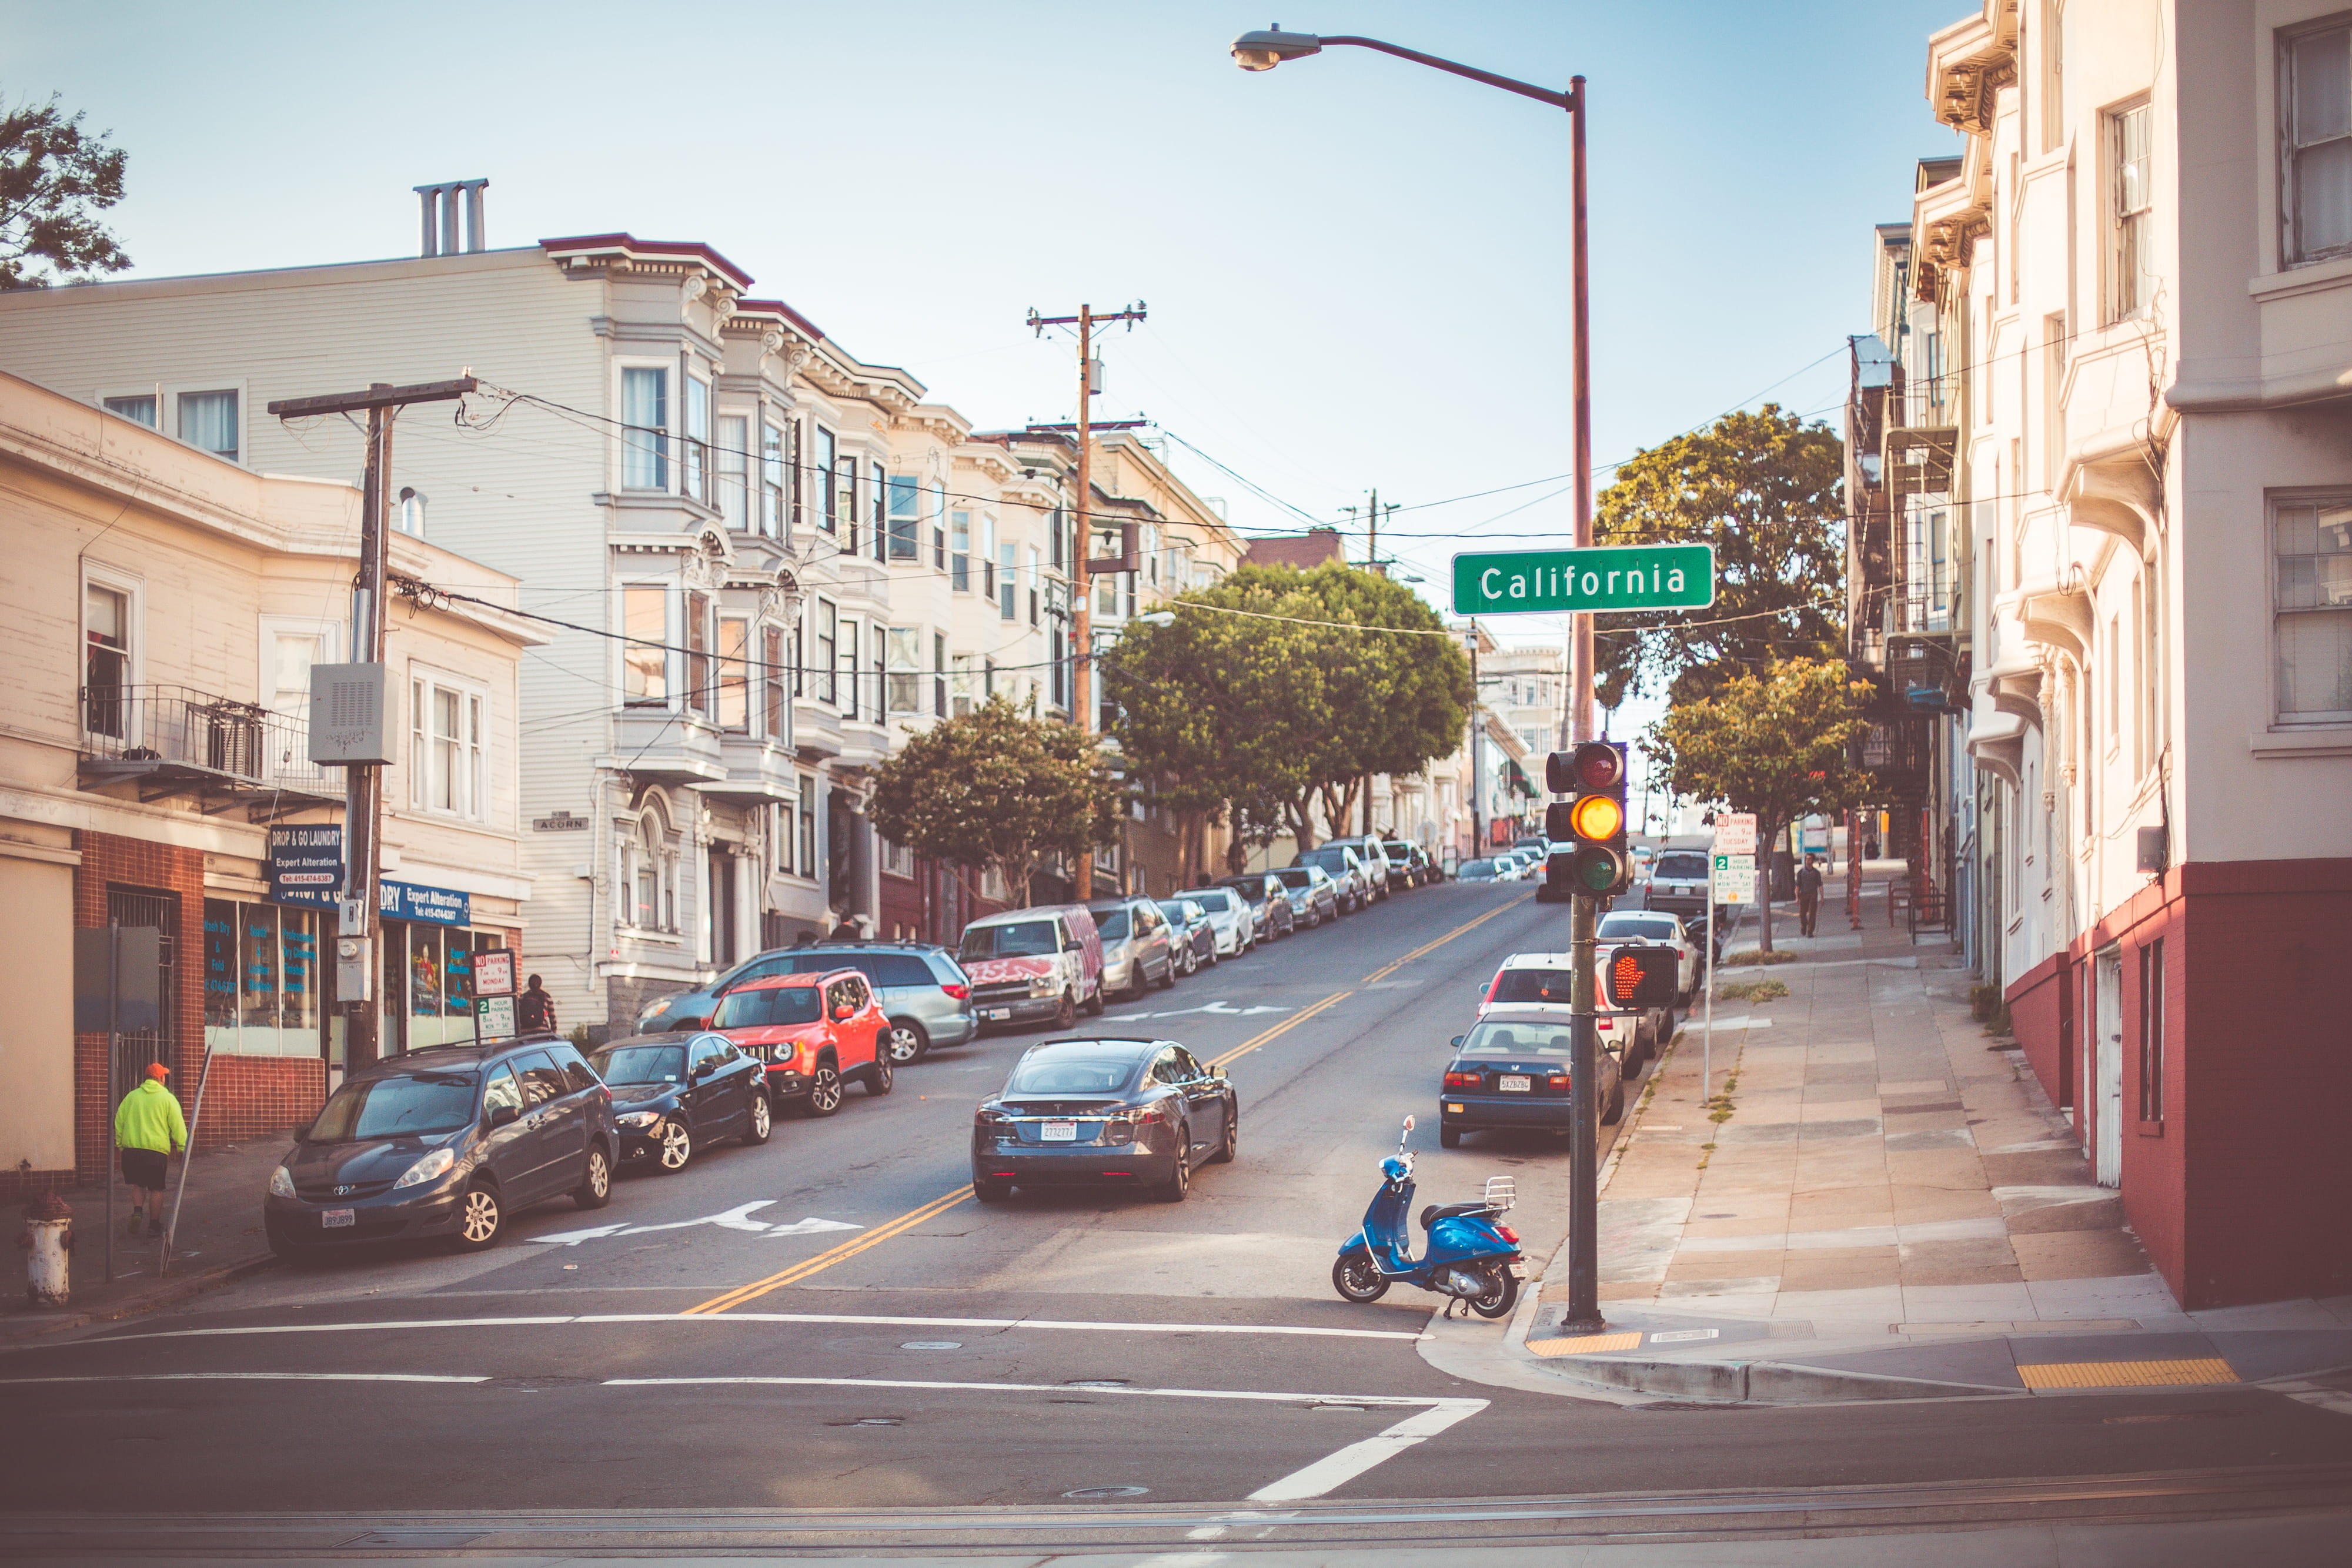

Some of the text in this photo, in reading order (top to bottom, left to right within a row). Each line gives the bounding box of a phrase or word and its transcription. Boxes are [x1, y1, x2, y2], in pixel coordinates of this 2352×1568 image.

[1481, 563, 1684, 599] California
[541, 820, 582, 828] ACORN
[1718, 815, 1728, 826] NO
[272, 830, 340, 846] DROP & GO LAUNDRY
[276, 857, 338, 869] Expert Alteration
[1718, 858, 1726, 869] 2
[407, 887, 429, 905] Expert
[430, 891, 462, 908] Alteration
[220, 921, 230, 936] Dry
[283, 945, 292, 960] Dry
[212, 959, 224, 971] Fold
[476, 955, 509, 966] NO PARKING
[479, 1001, 488, 1012] 2
